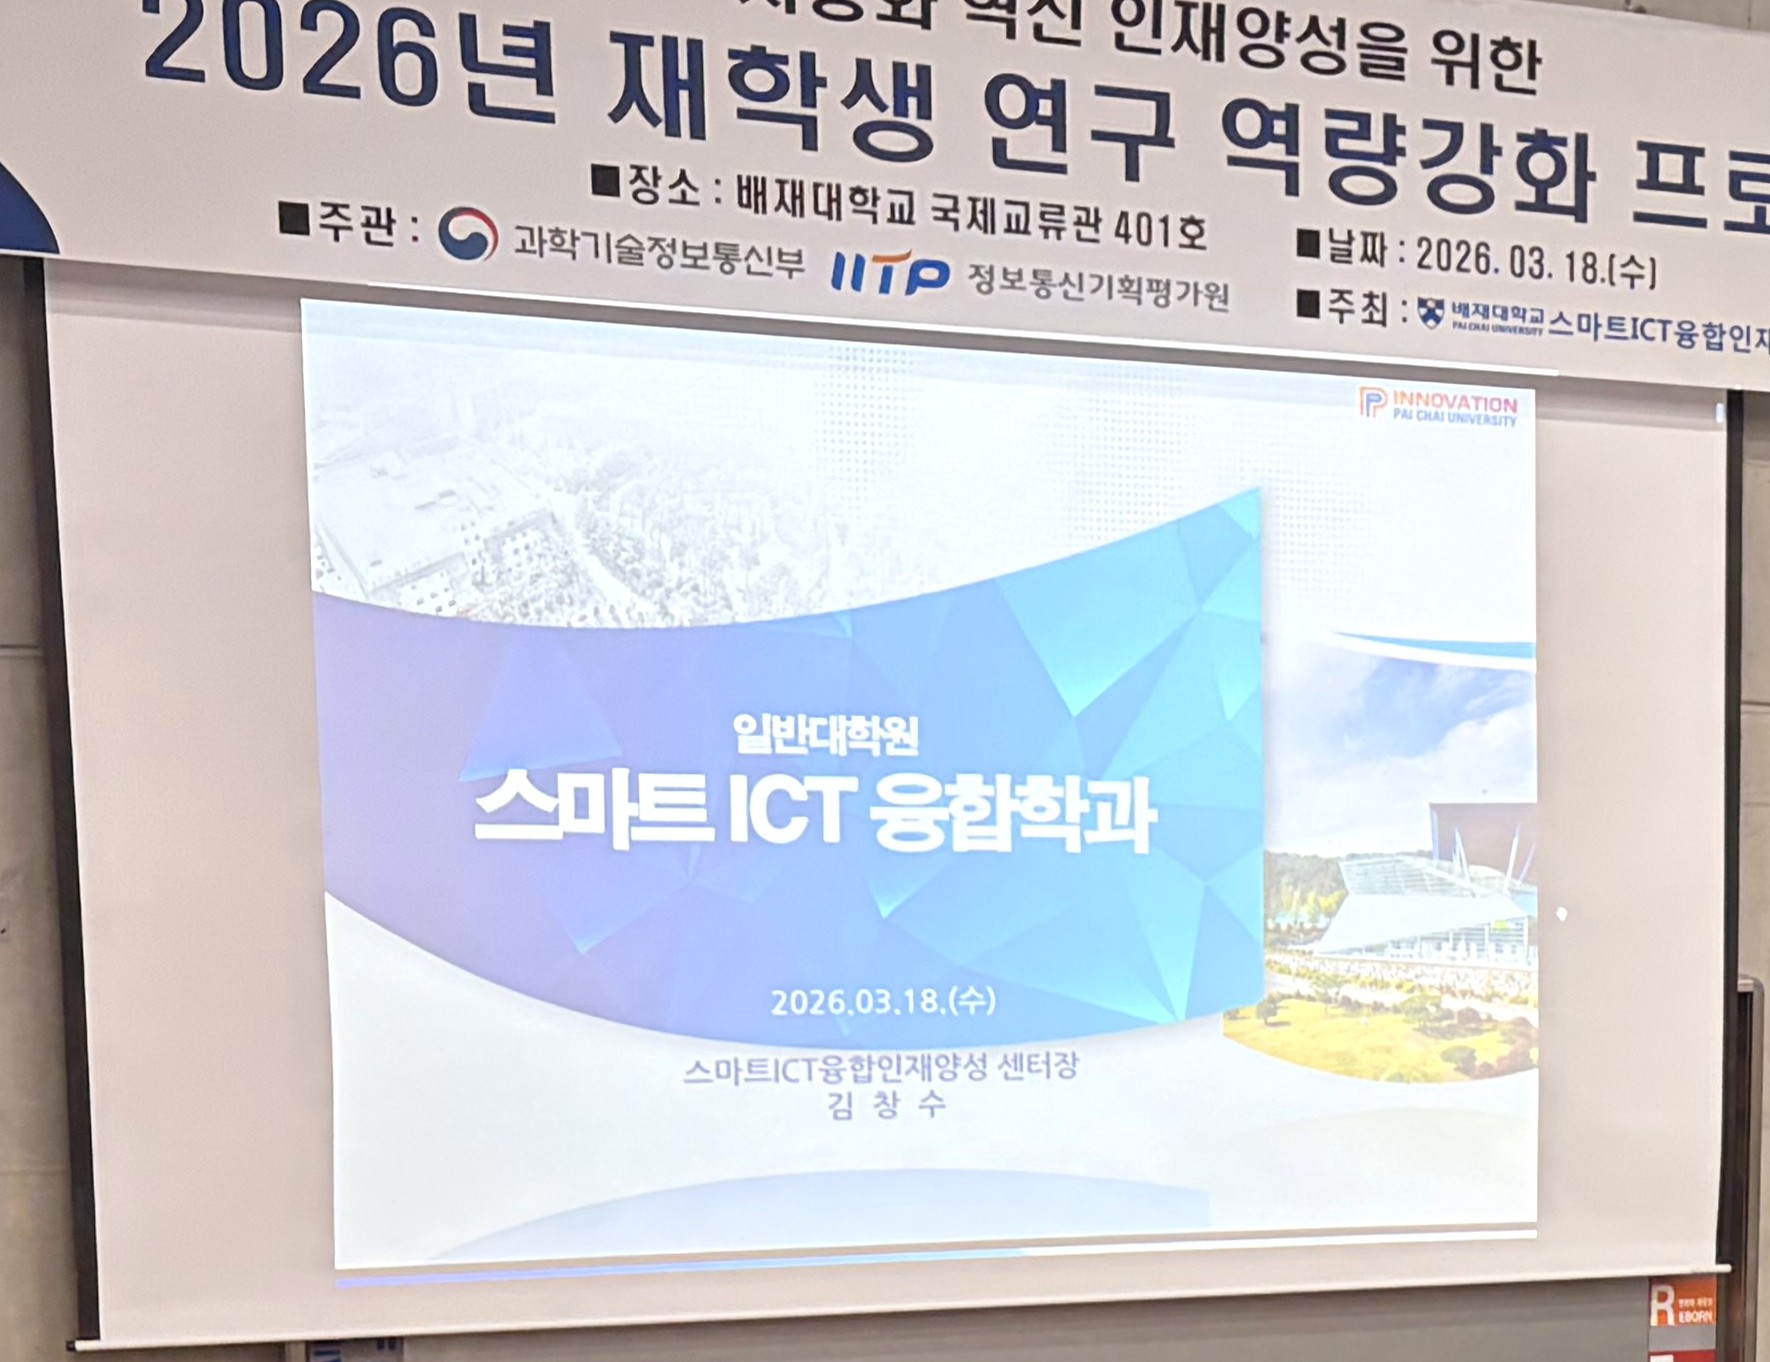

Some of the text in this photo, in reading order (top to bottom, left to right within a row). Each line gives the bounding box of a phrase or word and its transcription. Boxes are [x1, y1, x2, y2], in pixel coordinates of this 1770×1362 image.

[1110, 0, 1408, 82] 인재양성을
[1430, 29, 1543, 96] 위한
[142, 0, 556, 125] 2026년
[607, 30, 934, 163] 재학생
[984, 72, 1176, 183] 연구
[1221, 97, 1597, 224] 역량강화
[628, 163, 700, 207] 장소
[736, 174, 916, 226] 배재대학교
[931, 192, 1103, 245] 국제교류관
[1114, 210, 1207, 251] 401호
[319, 201, 397, 248] 주관
[515, 225, 805, 280] 과학기술정보통신부
[968, 264, 1229, 312] 정보통신기획평가원
[1328, 227, 1388, 268] 날짜
[1328, 288, 1387, 328] 주최
[1452, 301, 1545, 324] 배재대학교
[1393, 390, 1519, 414] INNOVATION
[1393, 408, 1518, 428] PAI CHAI UNIVERSITY
[733, 713, 919, 756] 일반대학원
[474, 767, 1158, 854] 스마트 ICT 융합학과
[771, 986, 997, 1017] 2026.03.18.(수)
[684, 1051, 1081, 1087] 스마트ICT융합인재양성 센터장
[828, 1089, 947, 1121] 김 창 수
